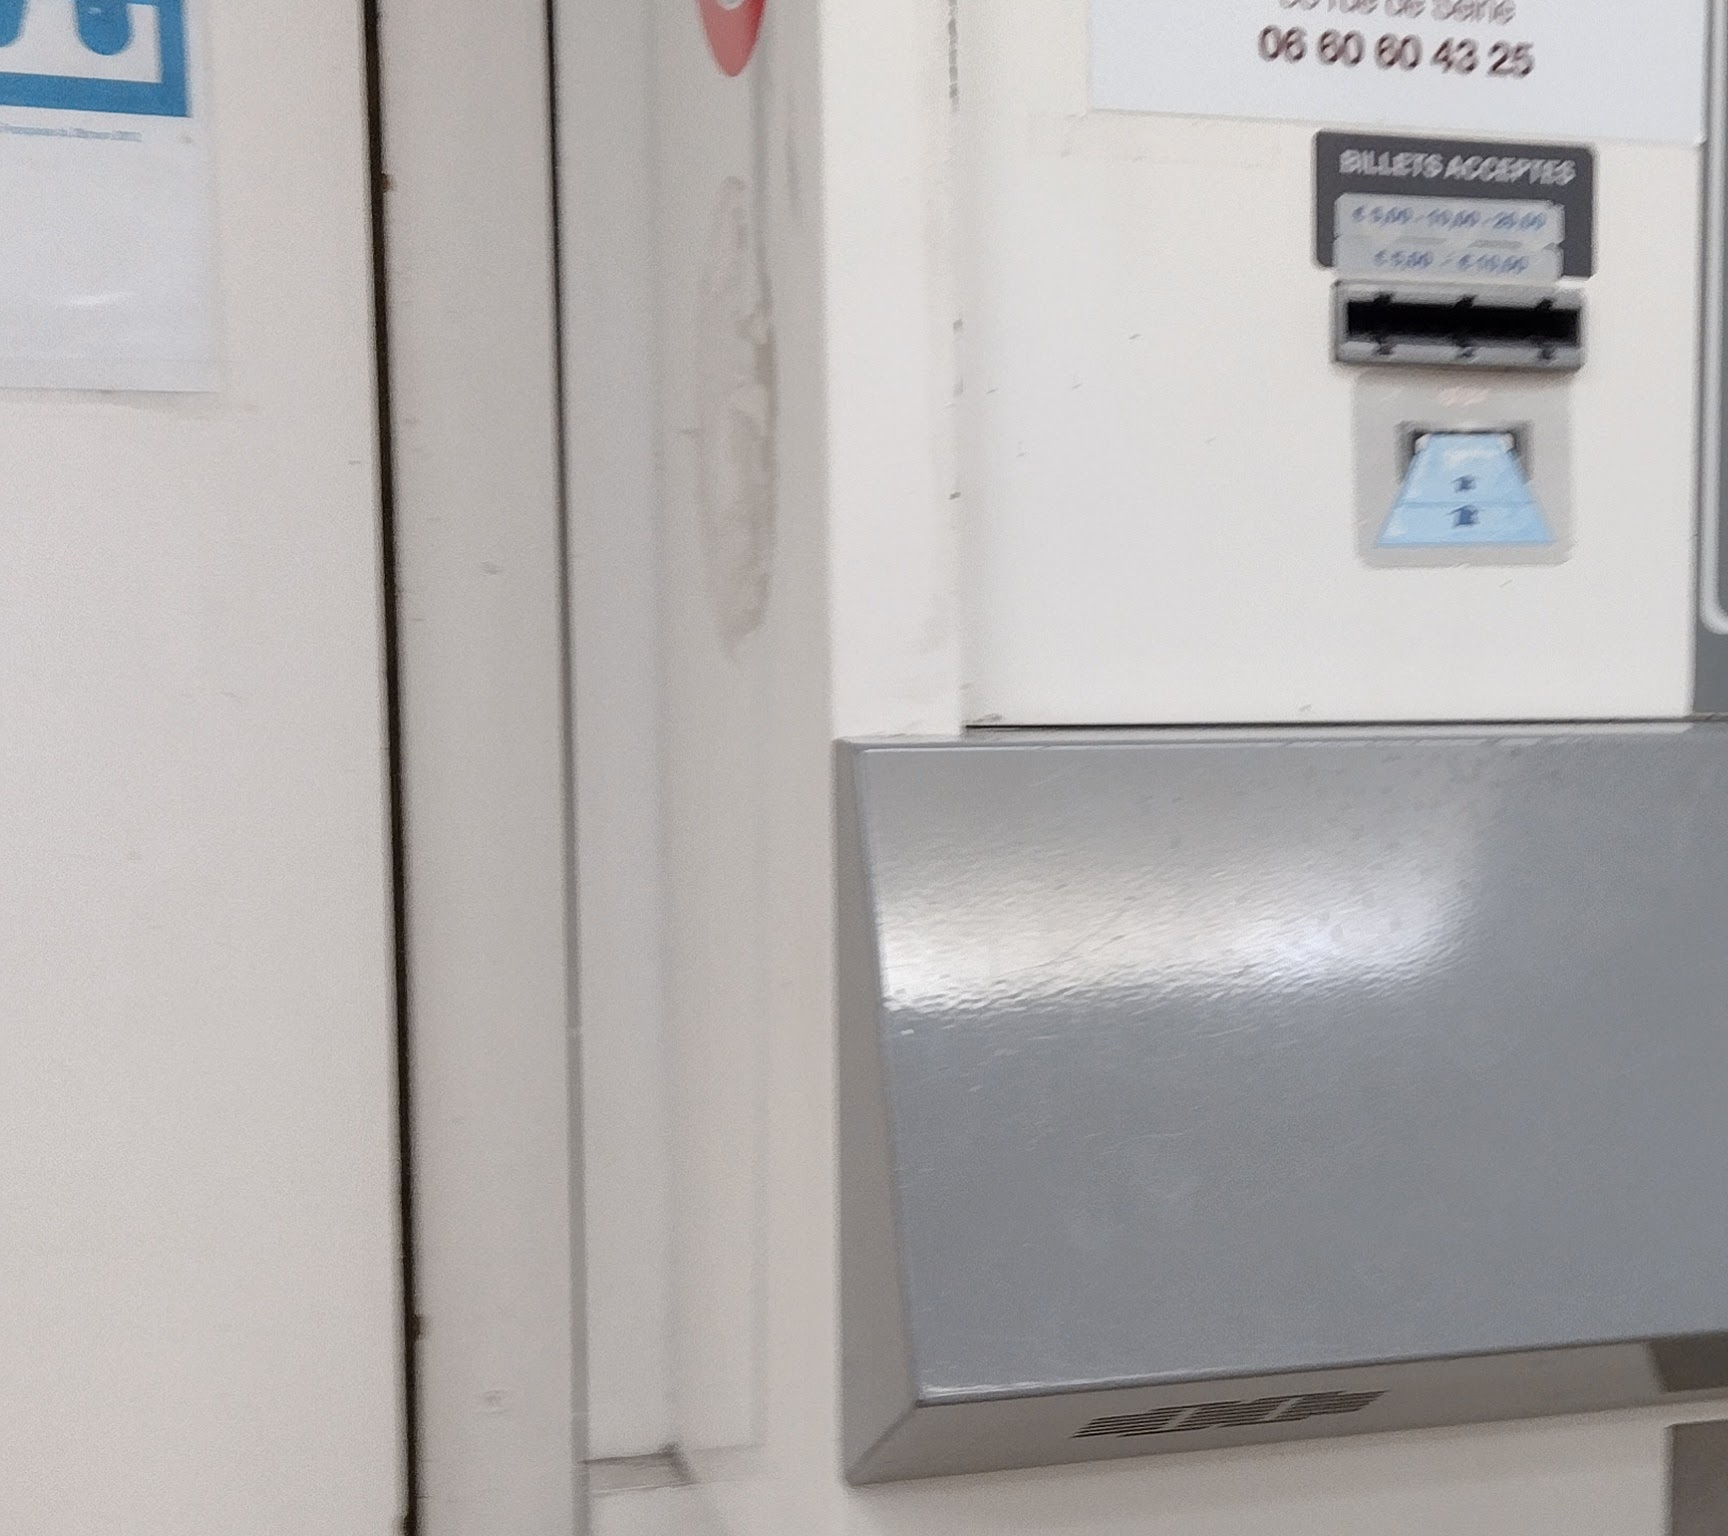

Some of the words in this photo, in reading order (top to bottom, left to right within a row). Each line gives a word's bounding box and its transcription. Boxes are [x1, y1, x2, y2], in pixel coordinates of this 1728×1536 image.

[1257, 24, 1308, 64] 06
[1315, 28, 1368, 68] 60
[1373, 31, 1424, 72] 60
[1429, 36, 1481, 76] 43
[1484, 40, 1536, 80] 25
[1339, 148, 1444, 179] BILLETS
[1442, 153, 1577, 187] ACCEPTES
